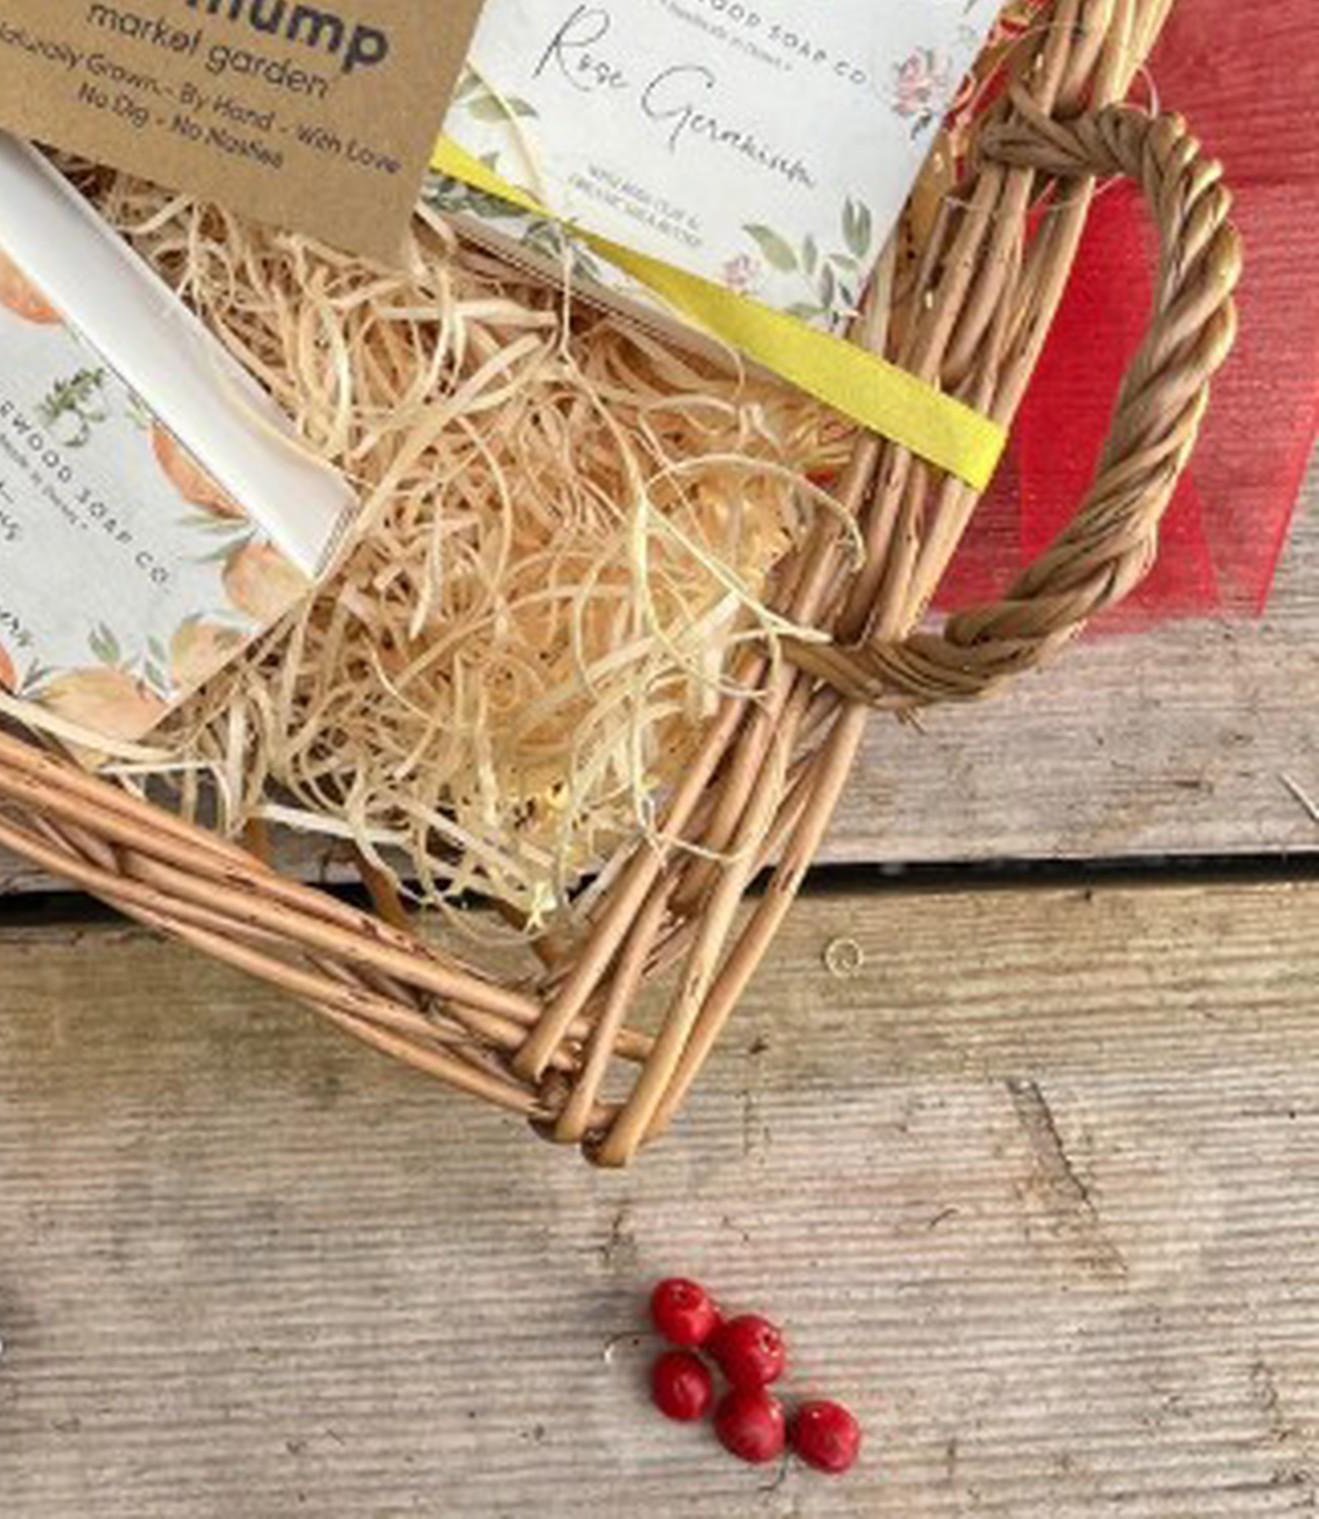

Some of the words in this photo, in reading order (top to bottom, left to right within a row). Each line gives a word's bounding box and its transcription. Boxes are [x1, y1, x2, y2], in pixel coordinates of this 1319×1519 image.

[86, 3, 203, 56] market
[205, 45, 329, 99] garden
[768, 25, 827, 62] SOAP
[78, 81, 109, 109] No
[112, 94, 149, 128] Dig
[173, 115, 202, 141] No
[205, 126, 283, 169] Nasties
[180, 82, 209, 112] By
[213, 94, 276, 131] Hand
[296, 123, 342, 154] With
[346, 139, 402, 174] Love
[532, 4, 629, 93] Rose
[641, 64, 815, 190] Geranium
[77, 488, 132, 543] SOAP
